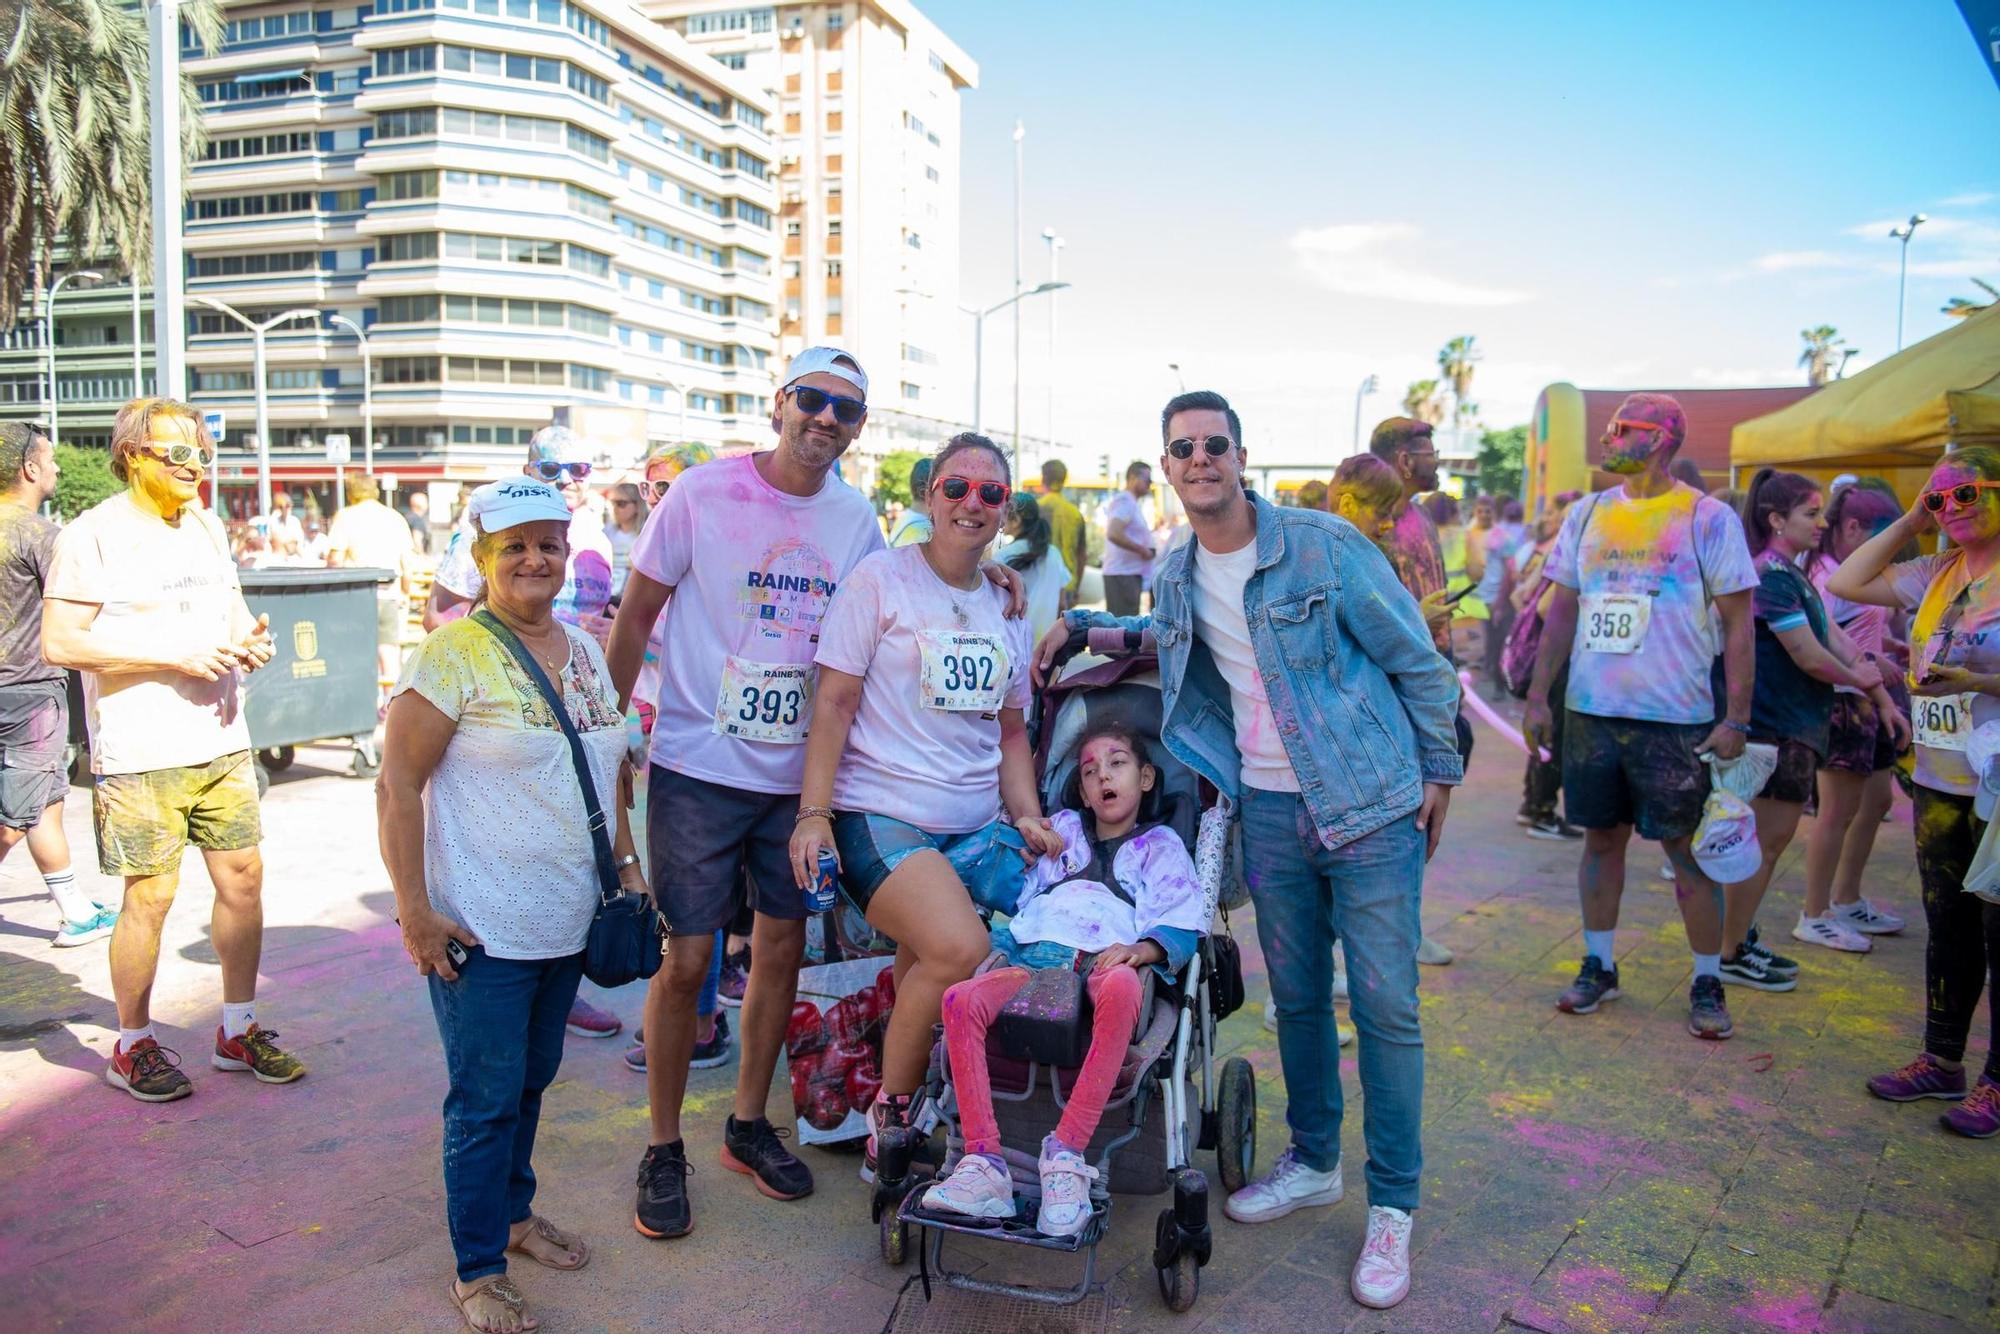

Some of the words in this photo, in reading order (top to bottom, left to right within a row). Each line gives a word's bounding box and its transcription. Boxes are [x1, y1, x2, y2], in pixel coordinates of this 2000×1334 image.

[1590, 612, 1631, 639] 358
[764, 670, 807, 679] RAINBOW
[943, 654, 994, 691] 392
[739, 686, 800, 726] 393
[1918, 699, 1957, 733] 360
